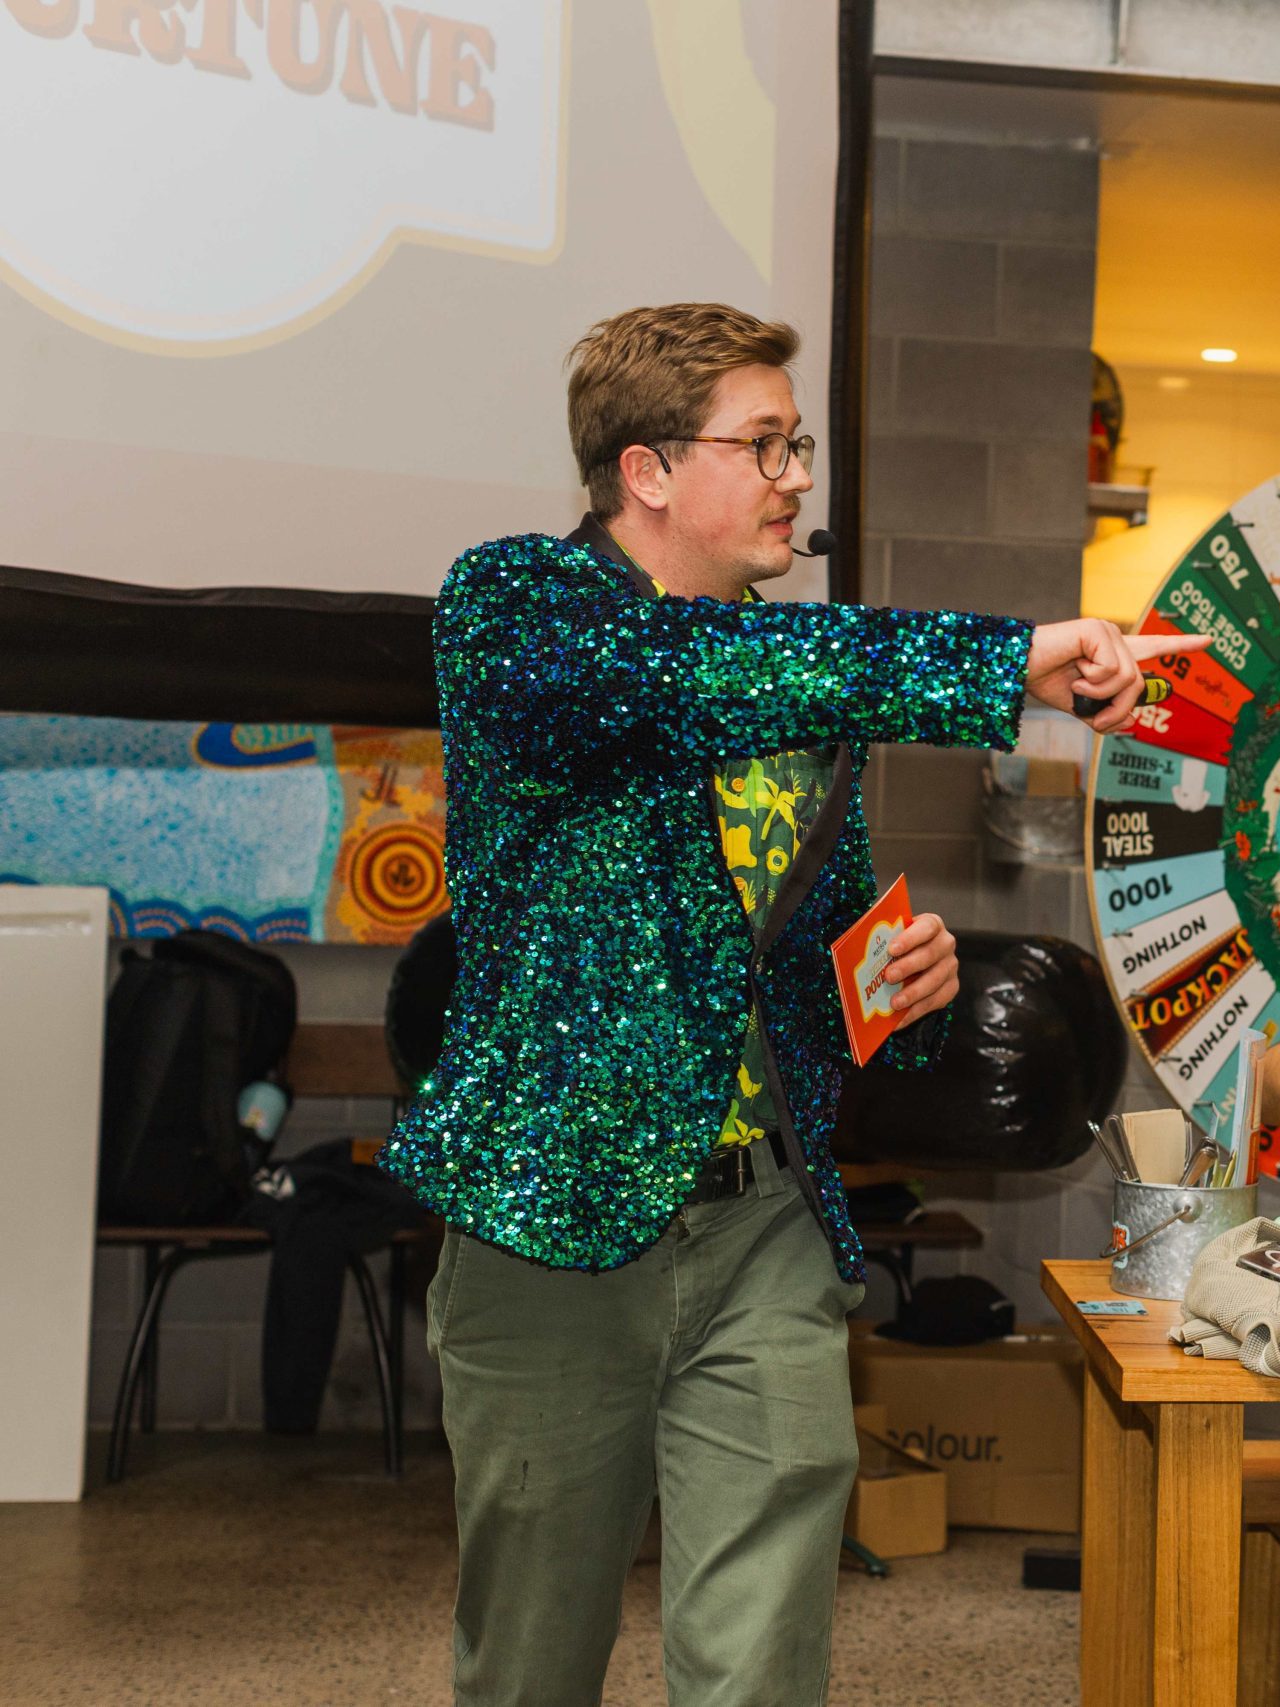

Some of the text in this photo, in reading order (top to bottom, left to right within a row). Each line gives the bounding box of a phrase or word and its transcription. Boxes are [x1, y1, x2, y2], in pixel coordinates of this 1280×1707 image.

[1210, 534, 1249, 591] 750
[1170, 590, 1246, 670] CHOOSE TO
[1181, 581, 1252, 655] LOSE 1000
[1108, 751, 1175, 775] T-SHIRT
[1118, 770, 1161, 790] FREE
[1102, 833, 1154, 858] STEAL
[1106, 811, 1149, 835] 1000
[1109, 873, 1173, 912] 1000
[1122, 915, 1207, 974] NOTHING
[1130, 928, 1254, 1032] JACKPOT
[1179, 995, 1249, 1081] NOTHING
[886, 1424, 1004, 1462] olour.
